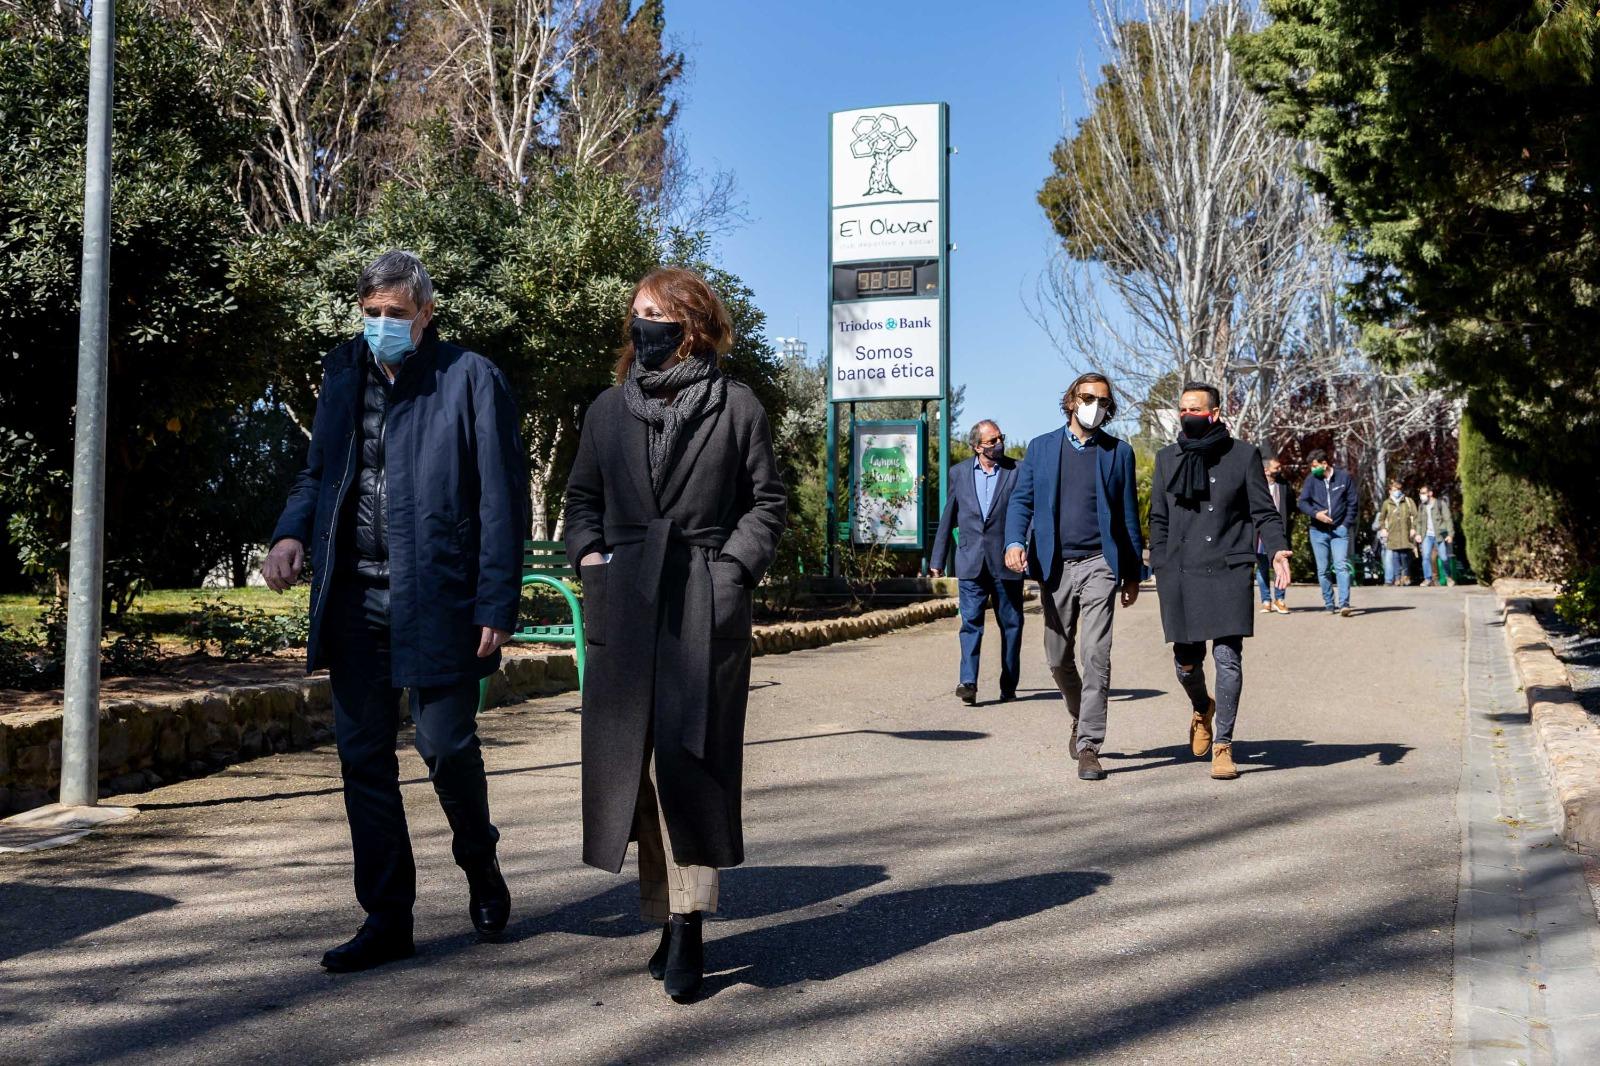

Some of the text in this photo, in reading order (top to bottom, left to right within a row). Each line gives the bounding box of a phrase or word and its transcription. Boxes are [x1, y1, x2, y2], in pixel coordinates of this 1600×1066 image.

[840, 219, 862, 238] El
[838, 316, 932, 333] Triodos Bank
[855, 345, 914, 361] Somos
[837, 363, 935, 381] banca ética
